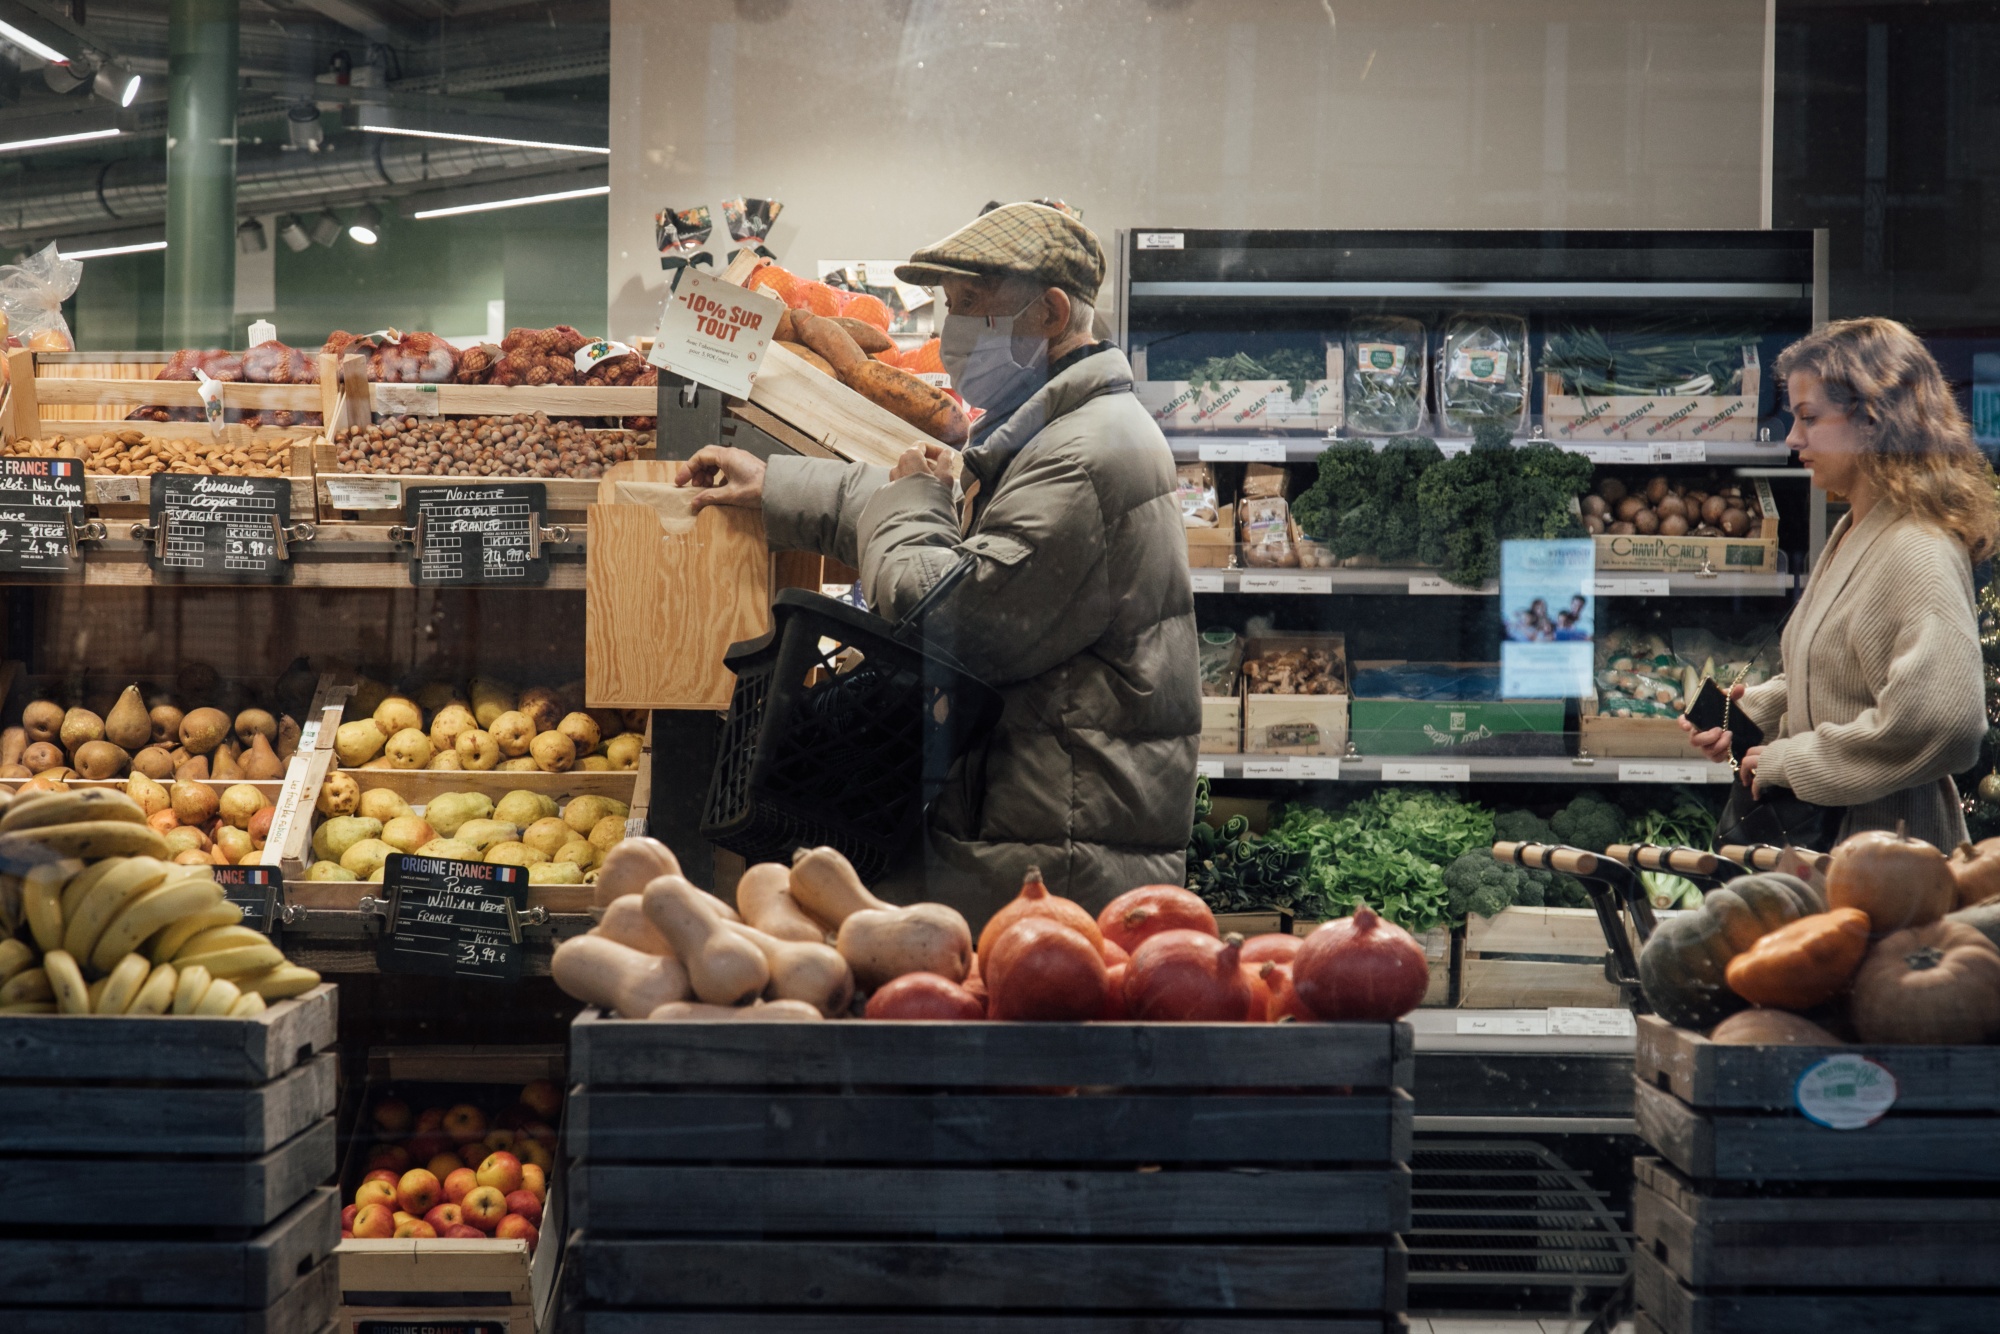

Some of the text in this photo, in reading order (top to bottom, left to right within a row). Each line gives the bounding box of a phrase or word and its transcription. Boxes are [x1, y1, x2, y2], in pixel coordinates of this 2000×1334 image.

[679, 293, 762, 331] -10% SUR
[696, 315, 741, 343] TOUT
[6, 461, 48, 476] FRANCE
[54, 477, 82, 498] Coque
[32, 494, 82, 513] Mix Coque
[190, 494, 238, 512] Coque
[168, 510, 223, 522] ESPAGNE
[450, 519, 502, 533] FRANCE
[232, 540, 274, 556] 5.99 €
[212, 869, 246, 885] ANCE
[401, 856, 493, 880] ORIGINE FRANCE
[417, 910, 454, 924] FRANCE
[462, 945, 506, 963] 3,99 €
